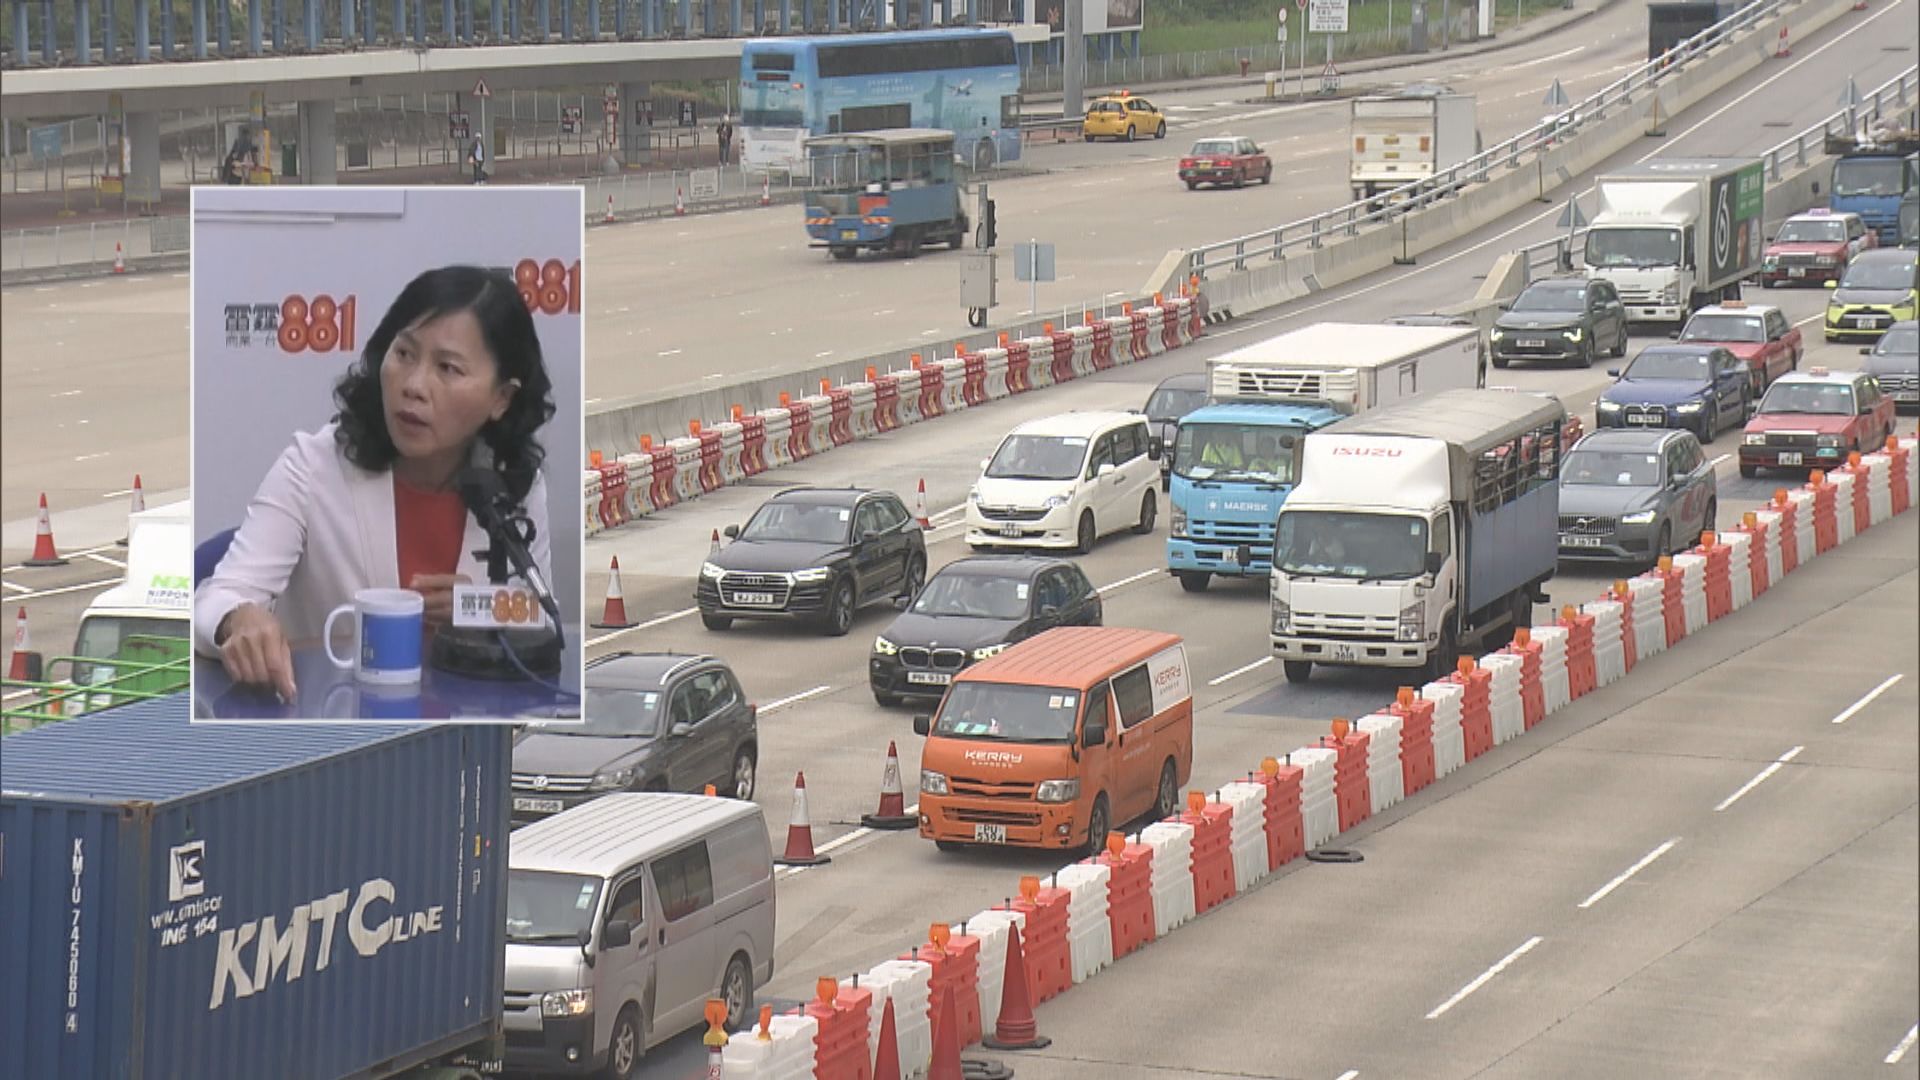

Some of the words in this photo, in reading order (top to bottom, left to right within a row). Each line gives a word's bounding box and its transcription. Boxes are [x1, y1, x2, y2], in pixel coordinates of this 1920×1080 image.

[278, 293, 356, 353] 881
[1332, 447, 1402, 457] ISUZU
[1223, 502, 1268, 511] MAERSK
[492, 589, 539, 623] 881
[964, 750, 1022, 763] KERRY
[209, 878, 395, 1010] KMTC
[392, 906, 443, 942] LINE
